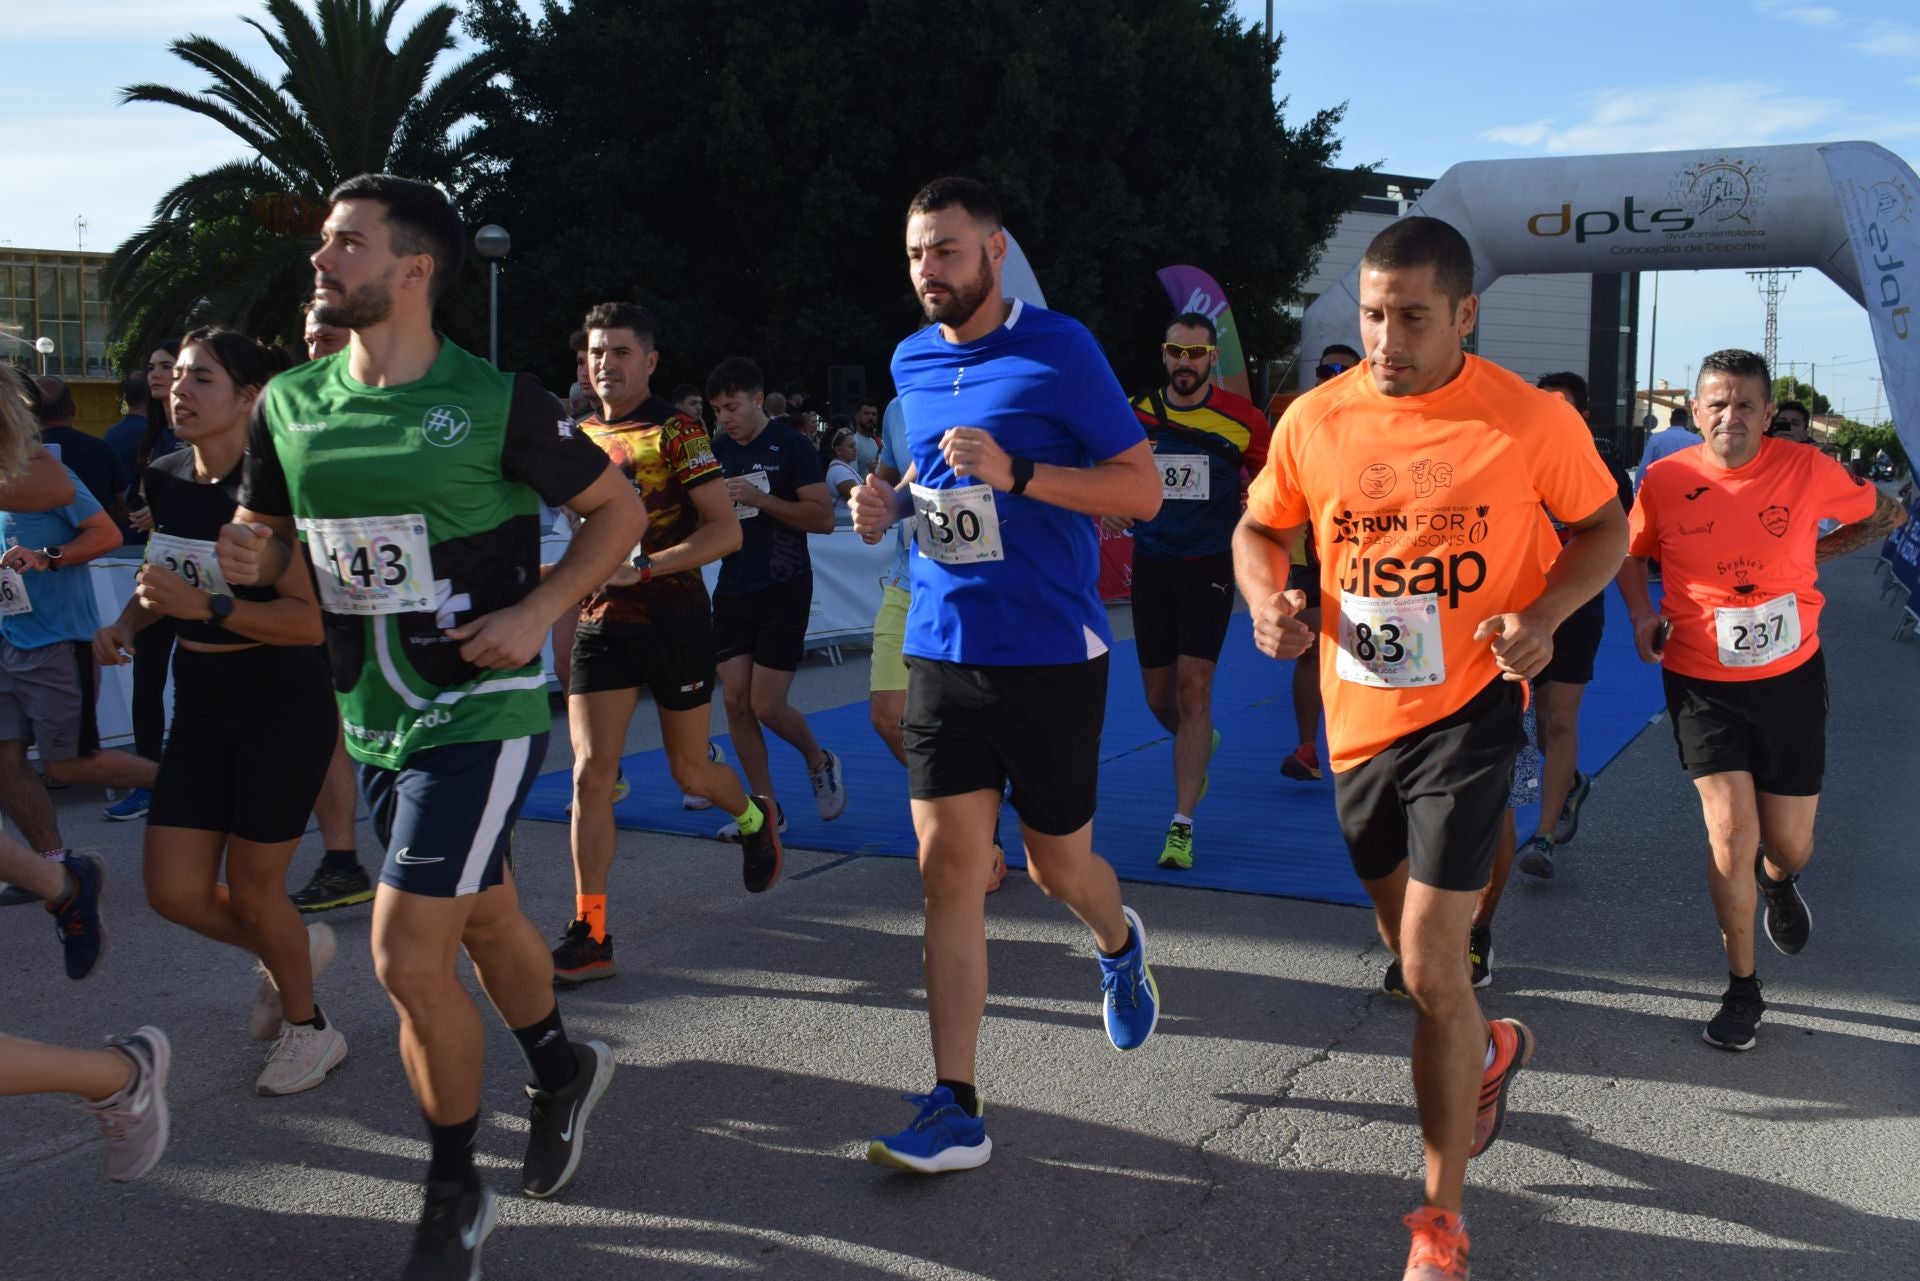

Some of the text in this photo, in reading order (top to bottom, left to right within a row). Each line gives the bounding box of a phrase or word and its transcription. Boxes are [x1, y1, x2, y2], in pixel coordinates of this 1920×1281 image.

[1527, 196, 1694, 243] dpts
[1684, 243, 1703, 252] de
[1706, 241, 1767, 254] Deportes
[427, 408, 467, 441] #y
[1164, 467, 1192, 487] 87
[922, 509, 980, 544] 130
[1362, 514, 1465, 532] RUN FOR
[1362, 534, 1465, 548] PARKINSON'S
[328, 544, 407, 588] 143
[0, 580, 13, 601] 6
[1356, 622, 1404, 663] 83
[1733, 614, 1784, 650] 237
